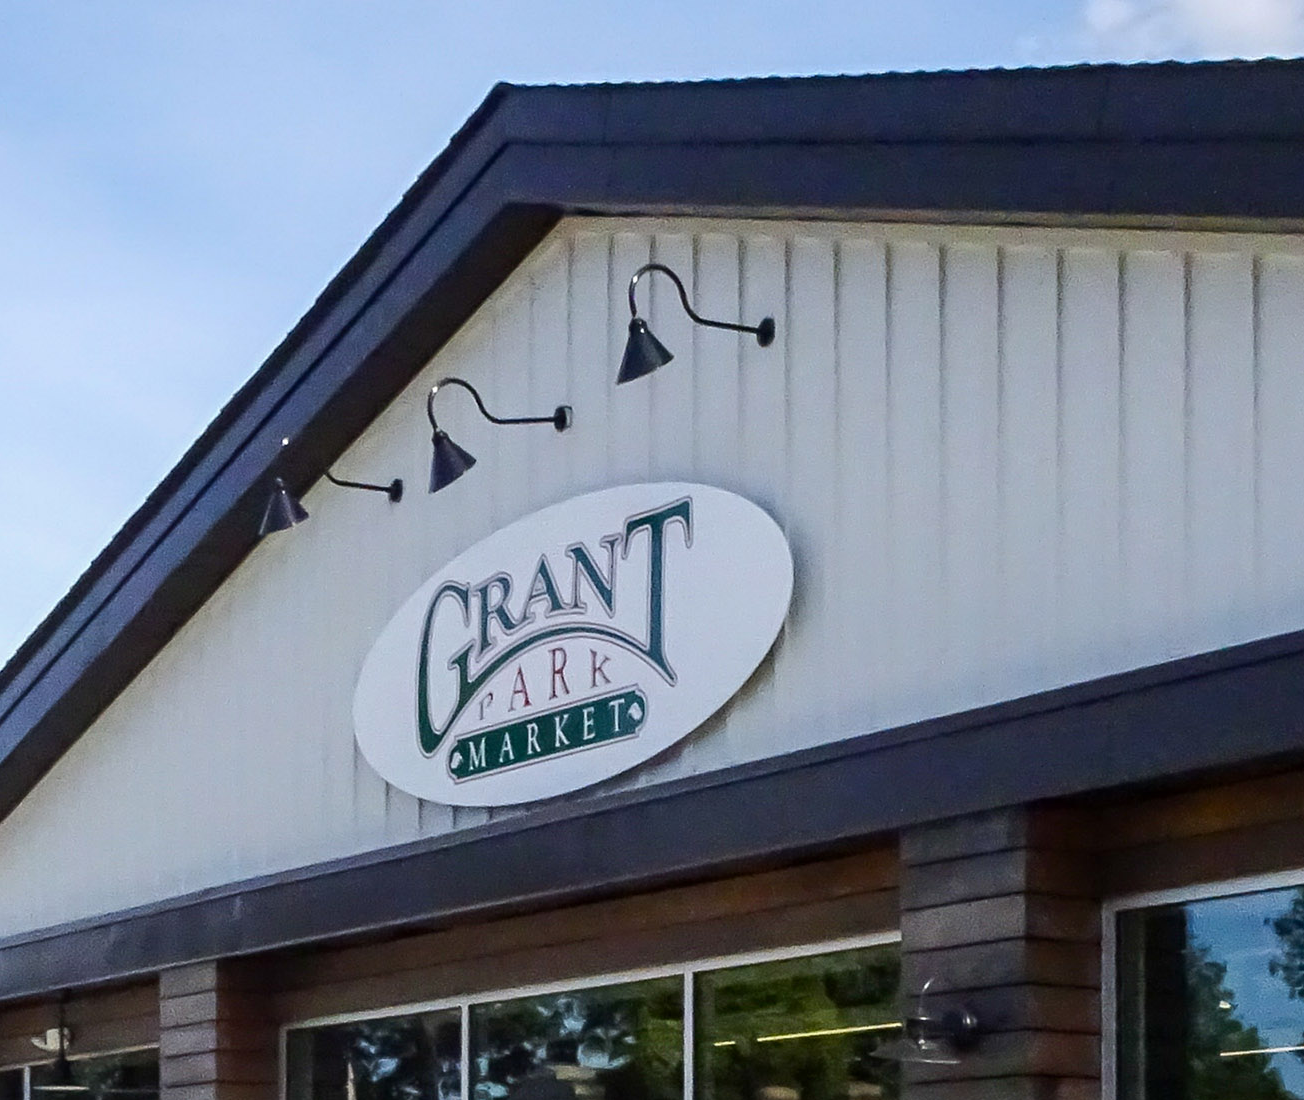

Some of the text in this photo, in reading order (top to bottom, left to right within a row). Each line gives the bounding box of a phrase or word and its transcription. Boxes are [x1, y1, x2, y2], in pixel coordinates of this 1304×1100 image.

[415, 495, 694, 759] GRANT
[478, 646, 612, 721] PARK
[468, 699, 627, 772] MARKET
